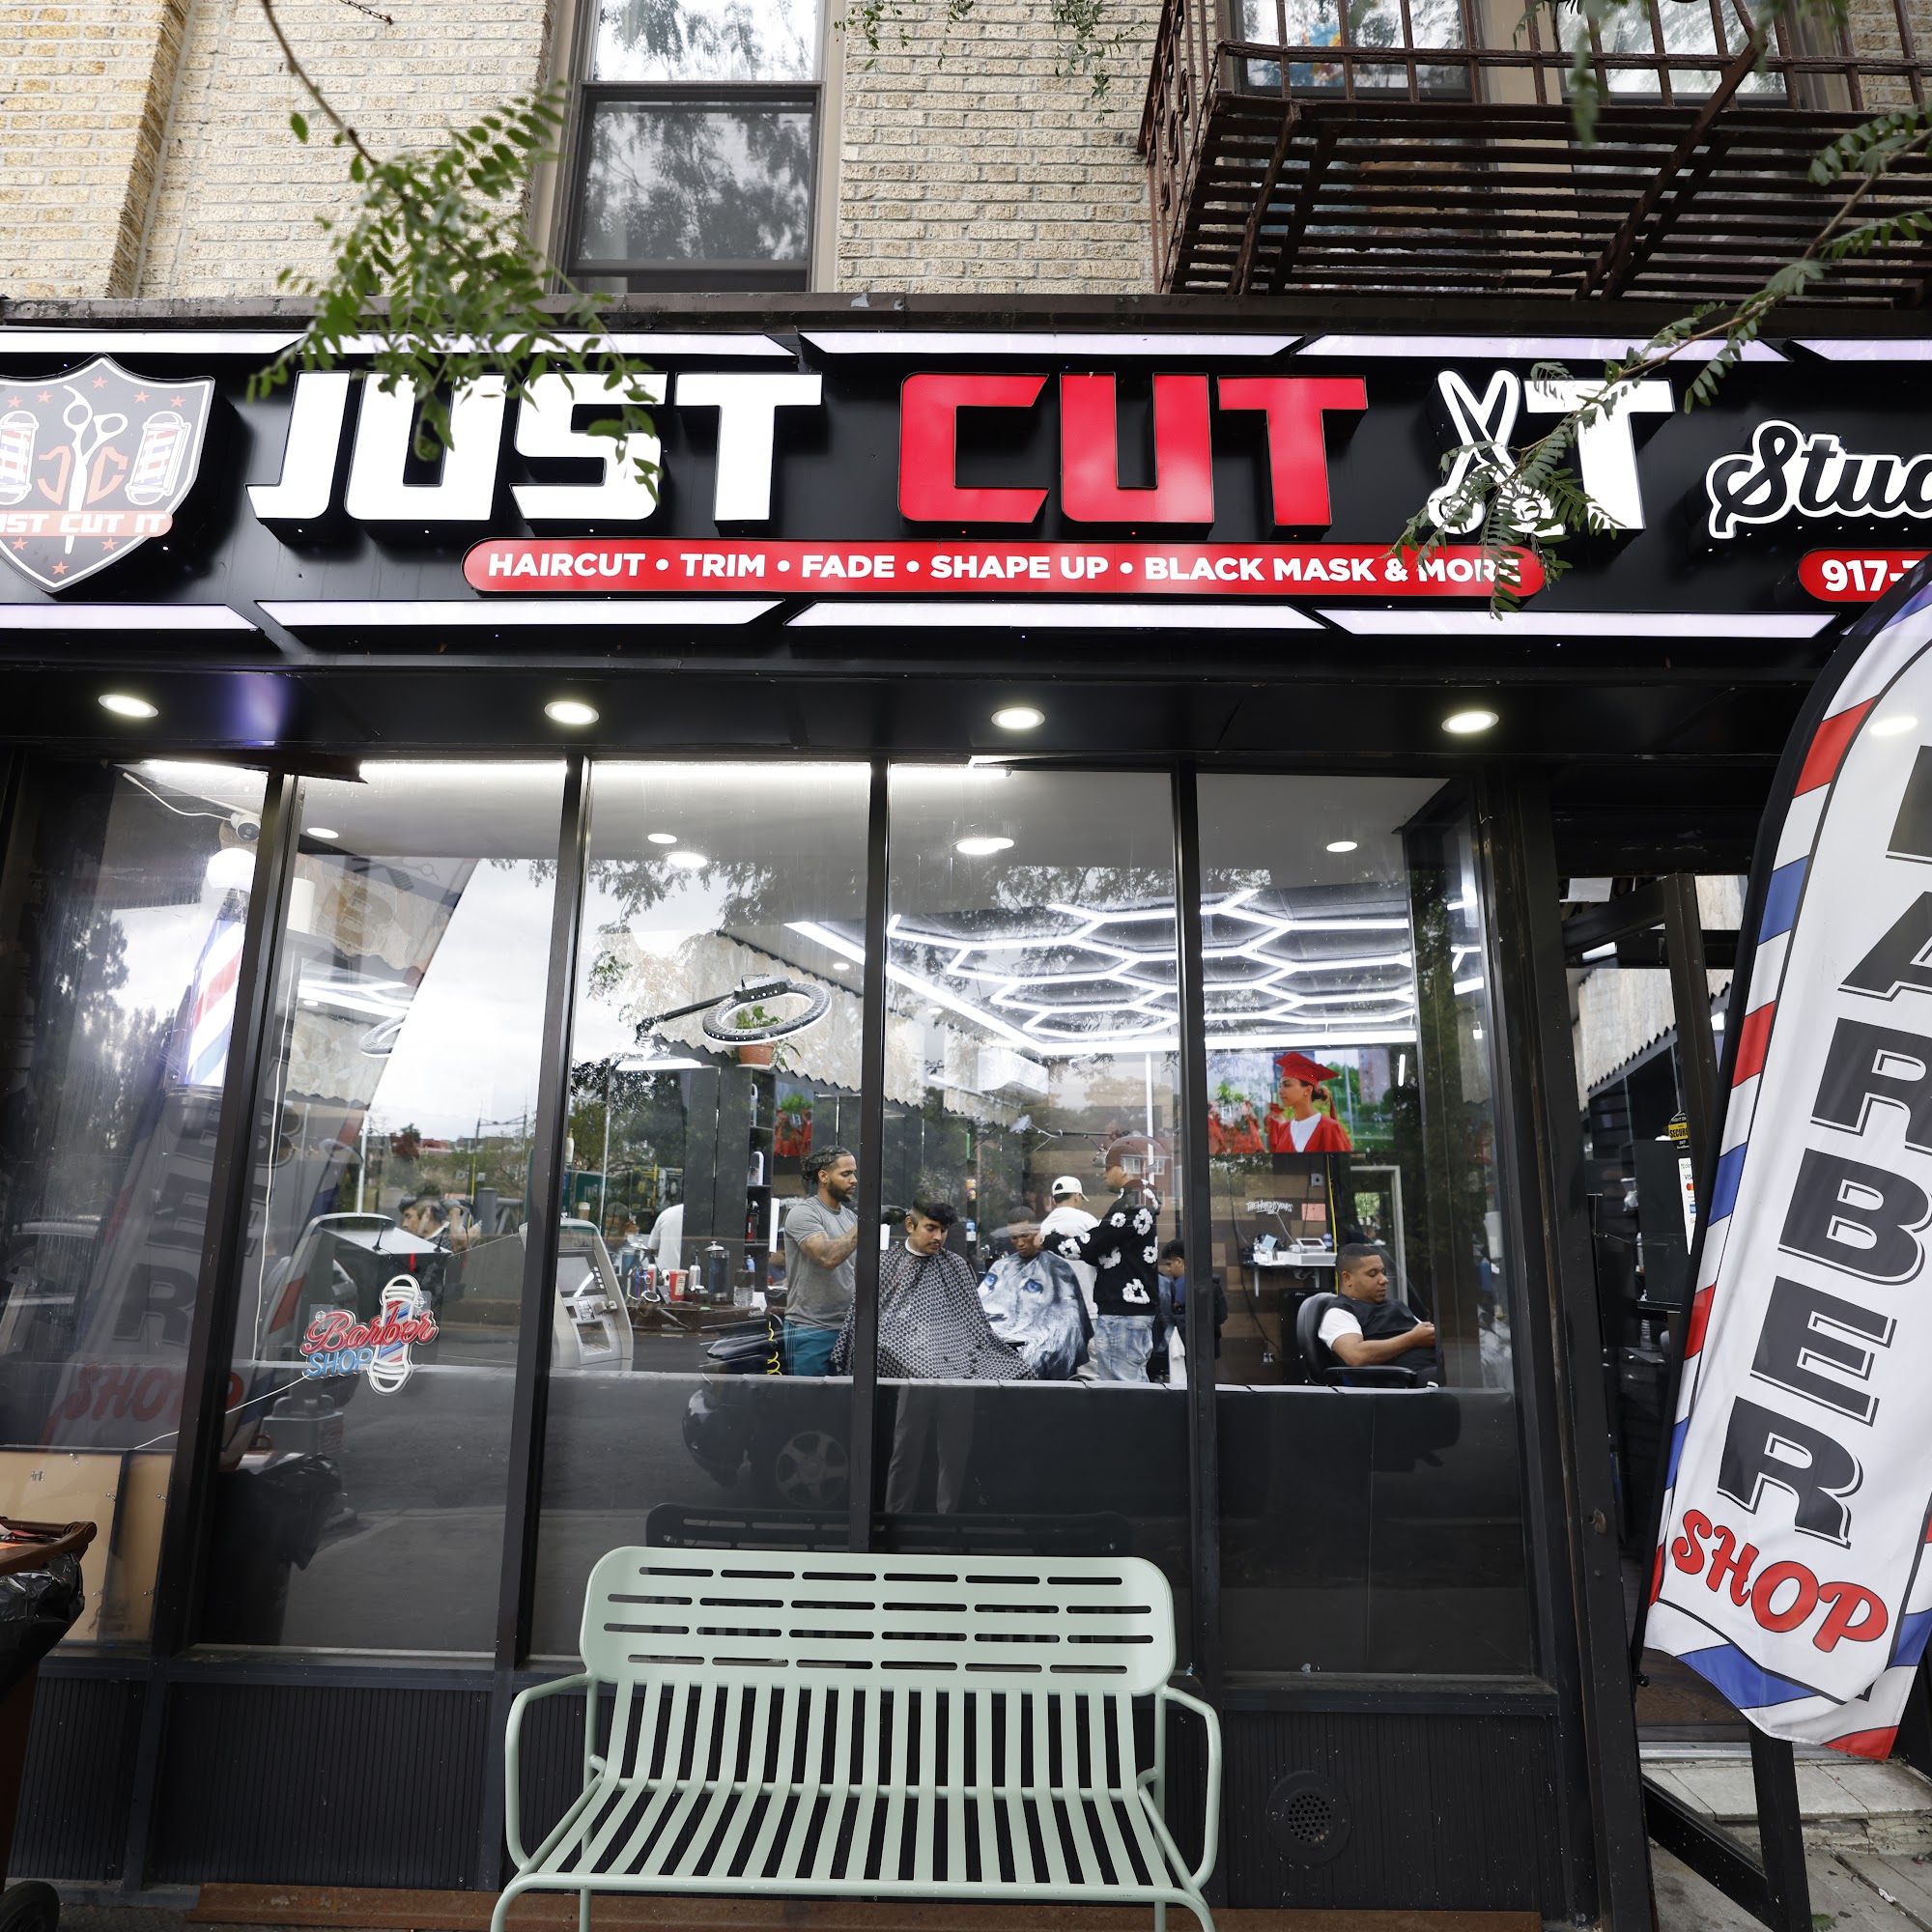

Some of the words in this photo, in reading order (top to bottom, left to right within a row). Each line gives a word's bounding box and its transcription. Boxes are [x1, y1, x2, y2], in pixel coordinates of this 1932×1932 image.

[245, 371, 822, 522] JUST
[897, 373, 1368, 526] CUT
[60, 513, 125, 533] CUT
[134, 513, 167, 533] IT
[487, 553, 645, 577] HAIRCUT
[680, 554, 766, 578] TRIM
[802, 554, 895, 579] FADE
[930, 554, 1051, 580] SHAPE
[1060, 555, 1109, 580] UP
[1145, 556, 1265, 582] BLACK
[1273, 557, 1377, 582] MASK
[1384, 557, 1408, 582] &
[1418, 558, 1521, 583] MORE
[301, 1305, 439, 1353] Barber
[305, 1348, 374, 1377] SHOP
[1671, 1508, 1889, 1654] SHOP
